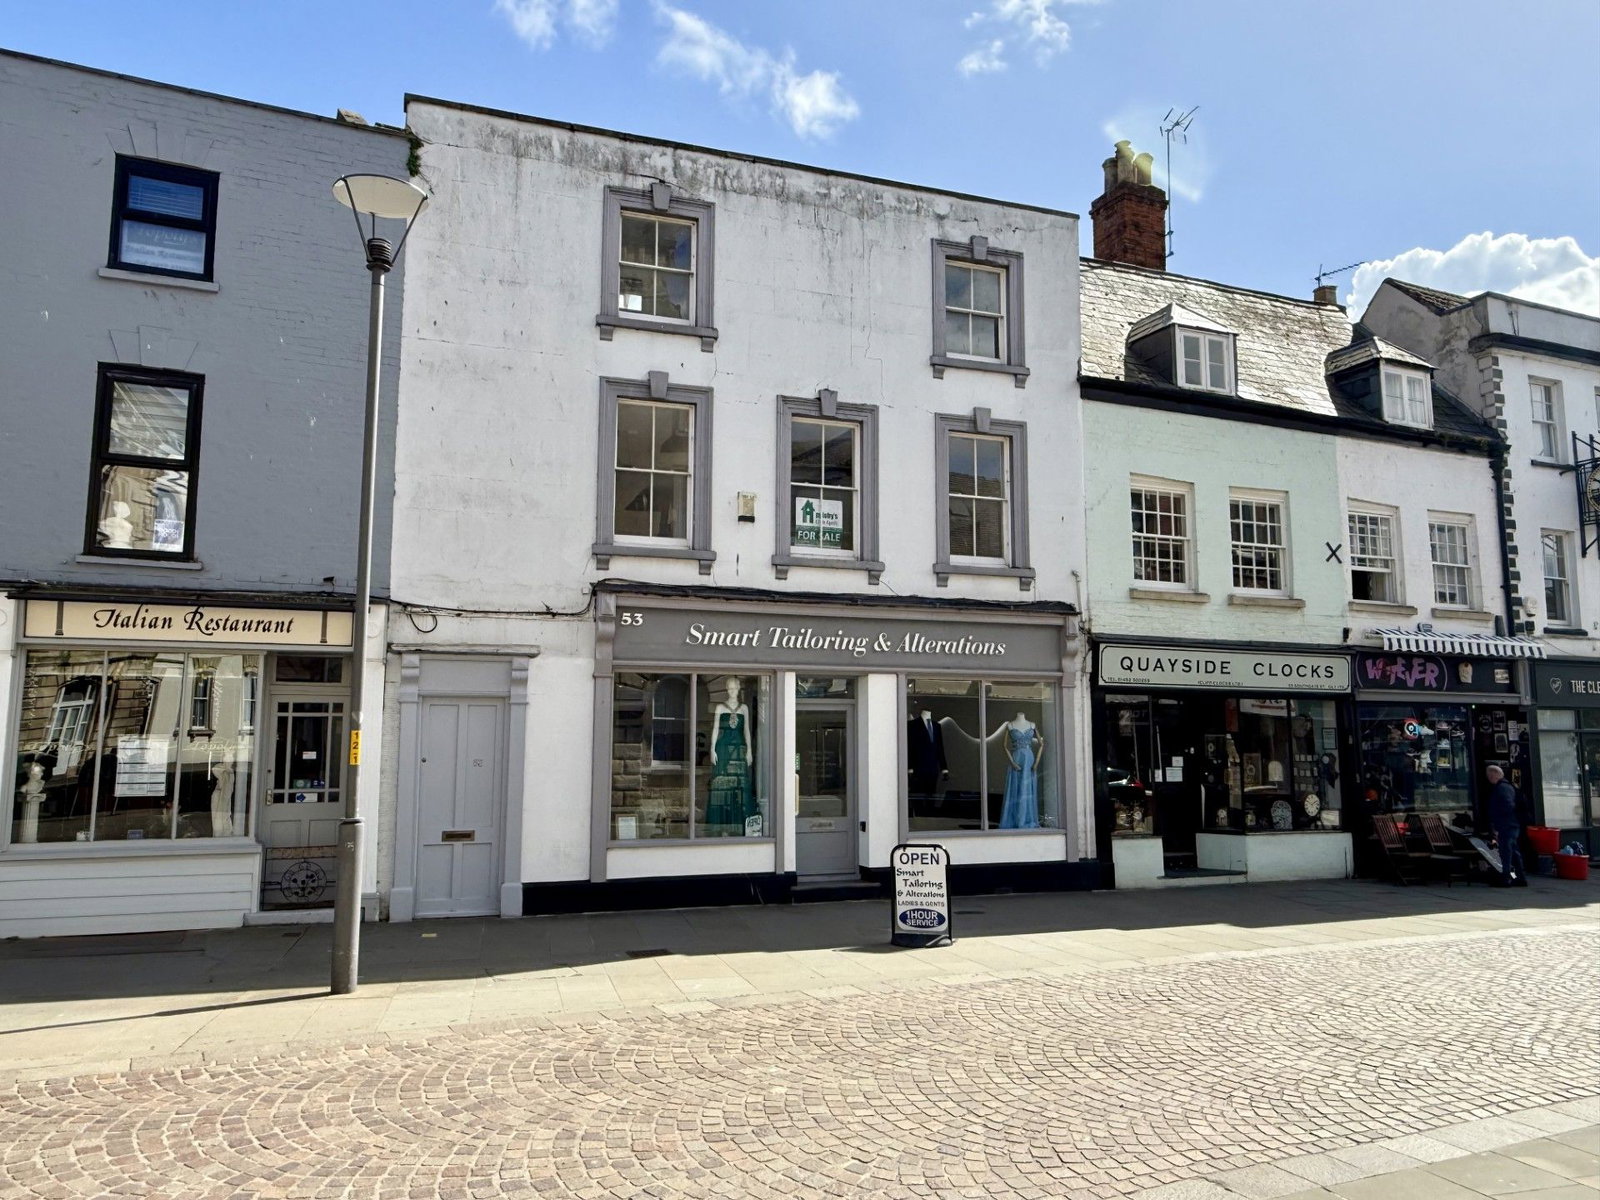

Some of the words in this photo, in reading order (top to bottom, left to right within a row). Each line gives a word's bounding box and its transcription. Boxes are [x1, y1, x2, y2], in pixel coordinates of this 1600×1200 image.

[798, 530, 816, 541] FOR
[93, 603, 174, 630] Italian
[183, 605, 295, 636] Restaurant
[620, 612, 644, 626] 53
[686, 623, 761, 647] Smart
[768, 626, 869, 658] Tailoring
[873, 632, 891, 651] &
[896, 632, 1006, 656] Alterations
[1119, 656, 1232, 675] QUAYSIDE
[1253, 662, 1335, 679] CLOCKS
[1570, 680, 1586, 694] THE
[899, 852, 940, 865] OPEN
[896, 868, 925, 877] Smart
[902, 878, 944, 890] Tailoring
[906, 890, 945, 898] Alterations
[906, 919, 939, 927] SERVICE
